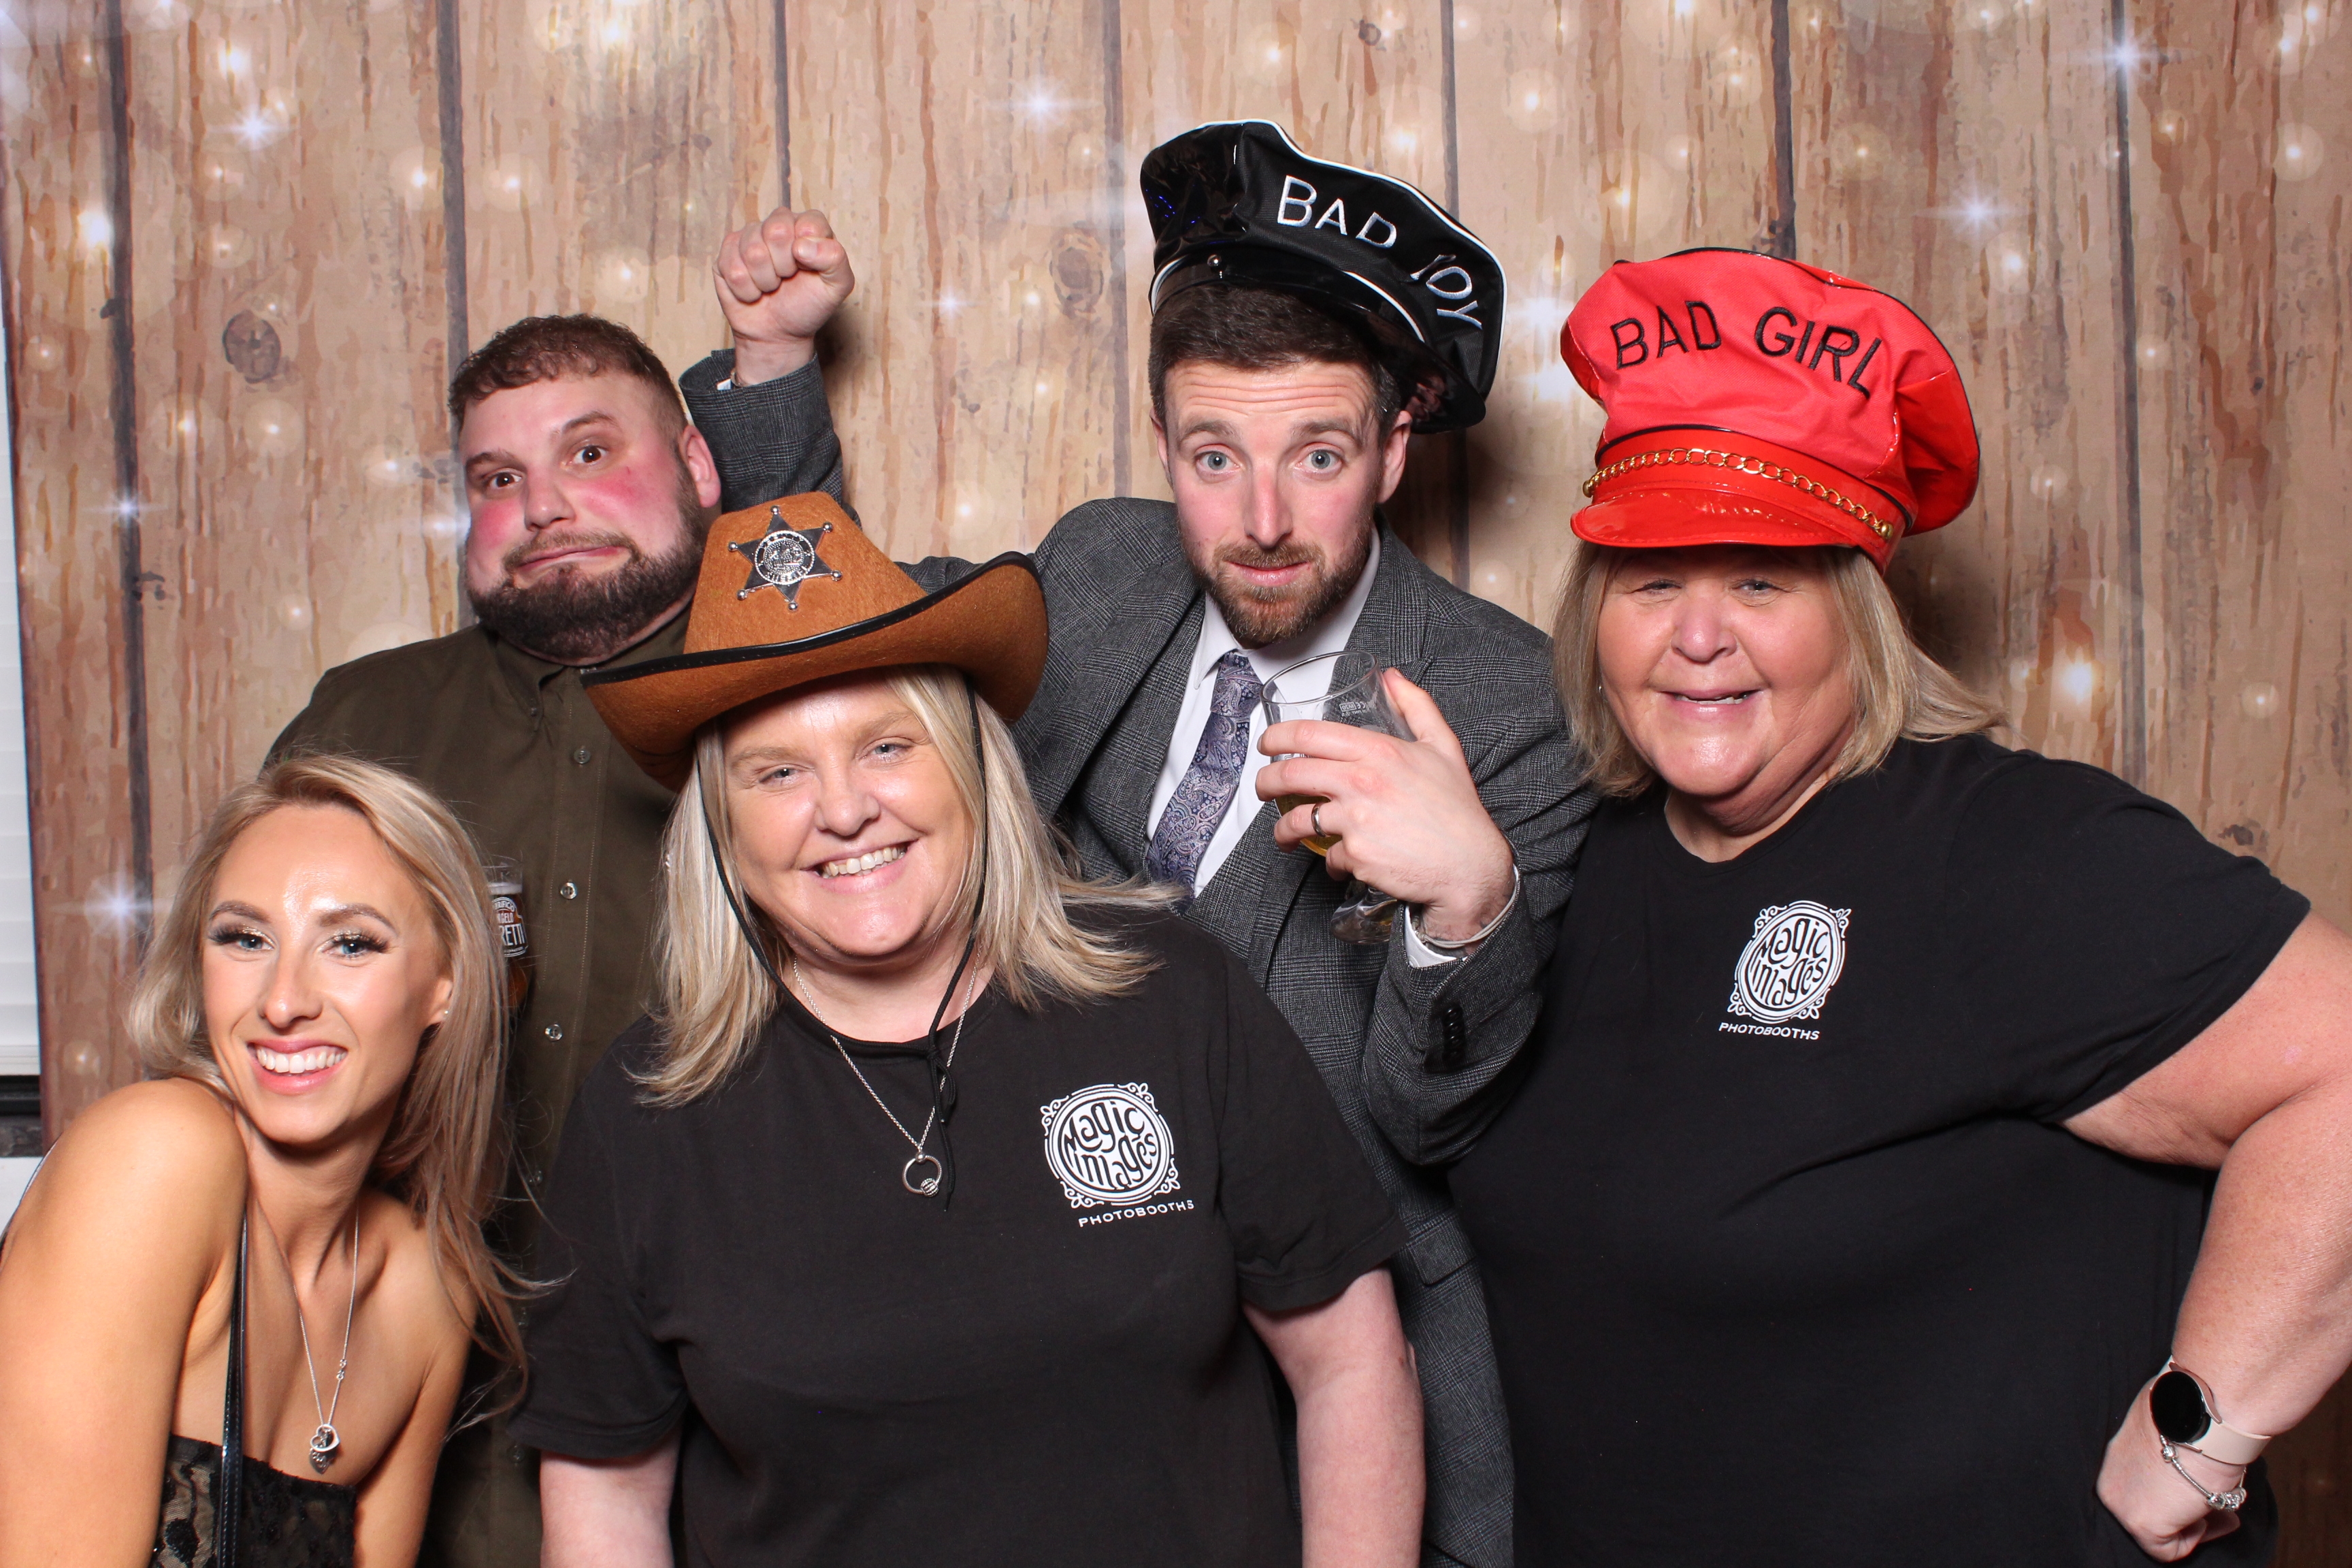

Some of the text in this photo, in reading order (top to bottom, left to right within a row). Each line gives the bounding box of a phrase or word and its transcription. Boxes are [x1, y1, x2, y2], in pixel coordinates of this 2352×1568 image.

[1277, 175, 1397, 248] BAD
[1610, 301, 1883, 400] BAD GIRL
[499, 924, 525, 945] RETTI
[1750, 918, 1828, 973] Magic
[1718, 1022, 1820, 1040] PHOTOBOOTHS
[1064, 1100, 1145, 1168] Magic
[1078, 1200, 1195, 1227] PHOTOBOOTHS
